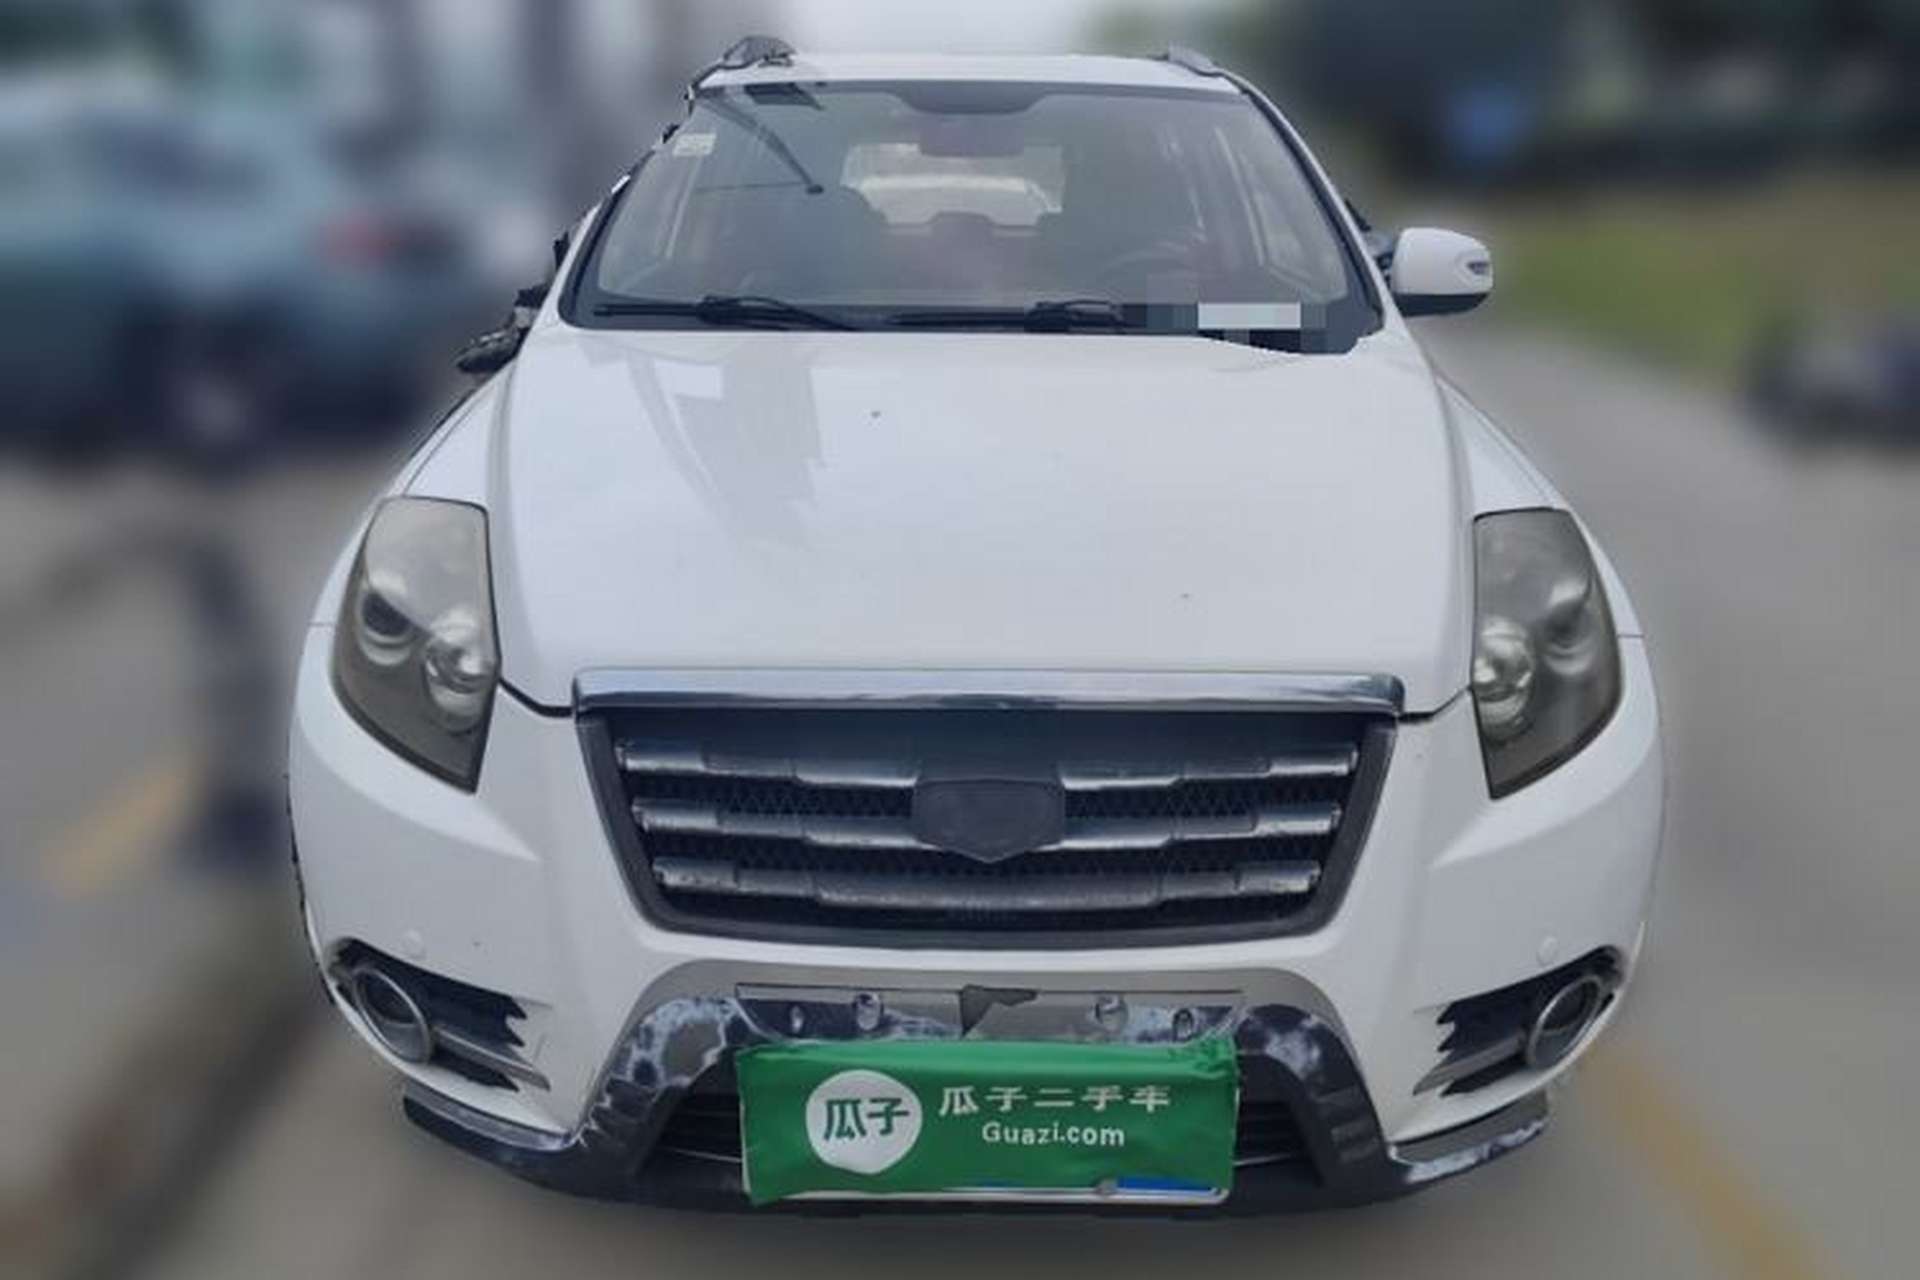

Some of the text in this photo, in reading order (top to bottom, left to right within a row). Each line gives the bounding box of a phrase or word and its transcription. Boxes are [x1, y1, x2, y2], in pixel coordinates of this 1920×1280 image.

[938, 1085, 1172, 1116] 瓜子二手车
[824, 1097, 910, 1140] 瓜子
[982, 1121, 1125, 1147] Guazi.com
